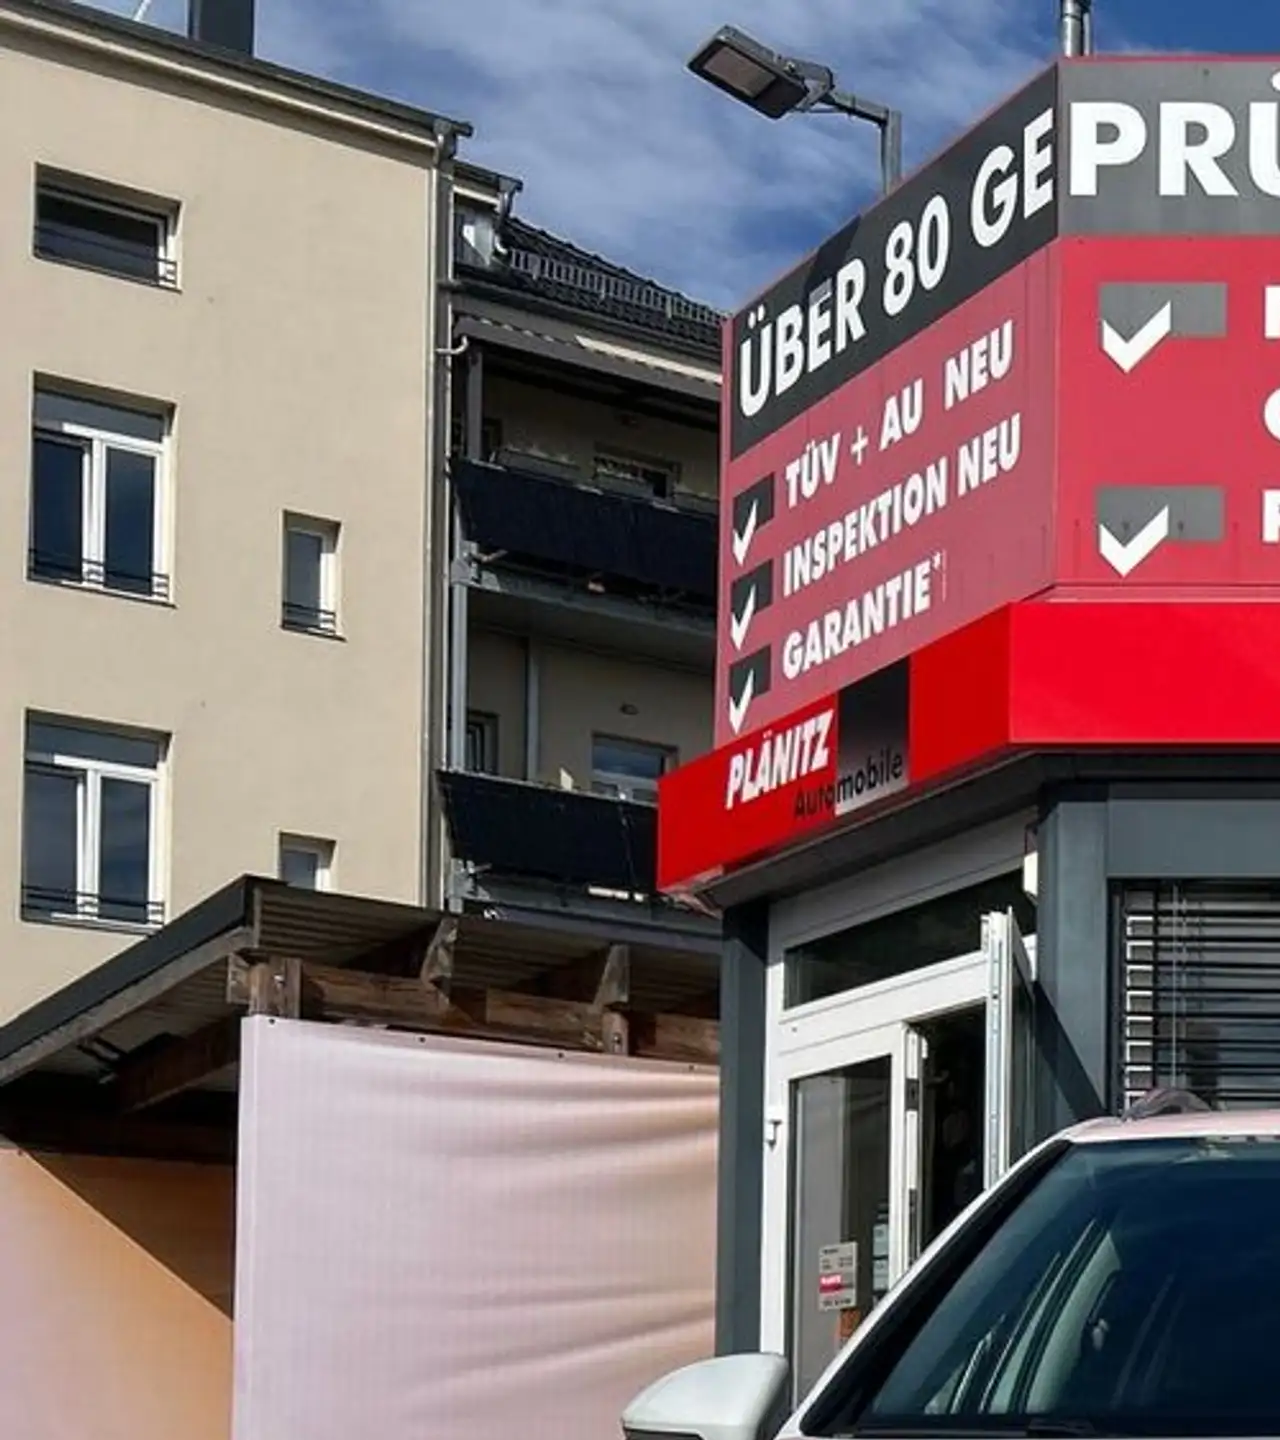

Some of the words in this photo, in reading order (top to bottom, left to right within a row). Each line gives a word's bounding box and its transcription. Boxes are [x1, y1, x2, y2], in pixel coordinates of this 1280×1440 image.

[738, 258, 868, 420] ÜBER
[883, 194, 951, 318] 80
[784, 455, 946, 597] INSPEKTION
[958, 413, 1022, 498] NEU
[785, 443, 839, 508] TÜV
[880, 379, 923, 455] AU
[945, 319, 1015, 412] NEU
[725, 709, 834, 811] PLÄNITZ
[794, 748, 904, 817] Automobile
